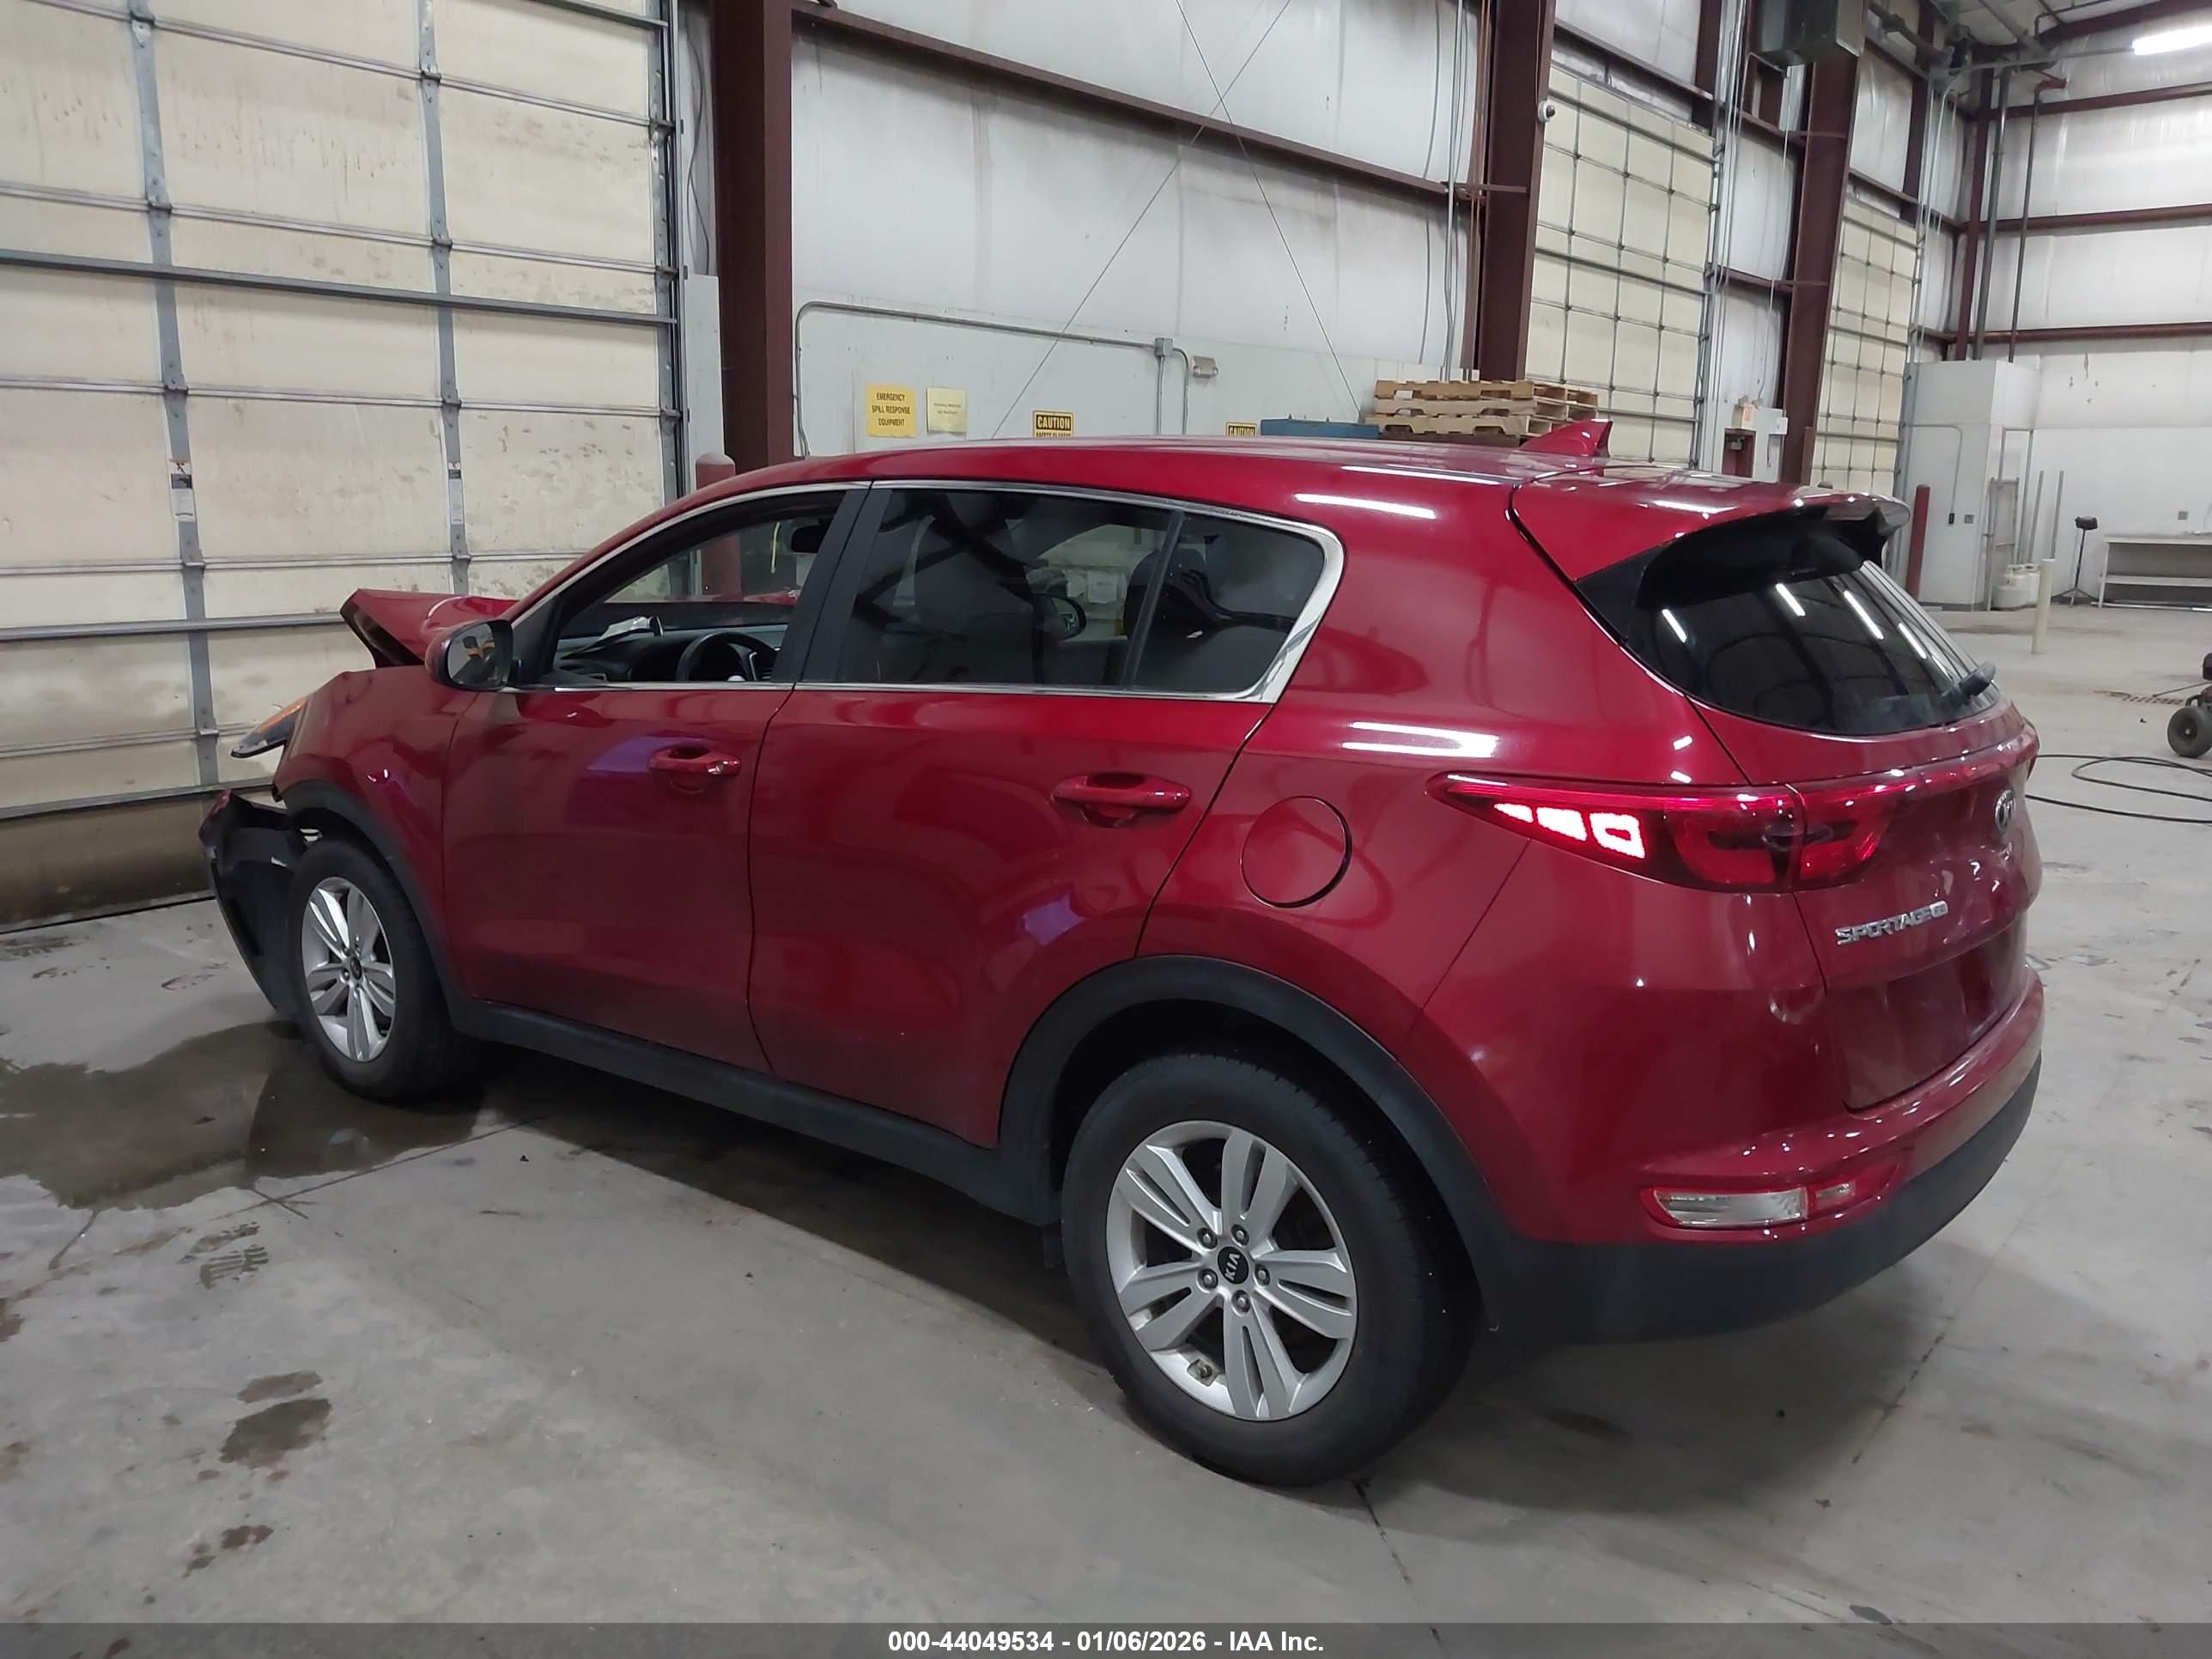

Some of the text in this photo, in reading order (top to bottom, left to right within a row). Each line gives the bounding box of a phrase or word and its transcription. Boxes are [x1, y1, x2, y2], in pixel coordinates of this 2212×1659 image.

[876, 392, 905, 401] EMERGENCY
[872, 404, 910, 414] SPILL RESPONSE
[1037, 416, 1070, 429] CAUTION
[1835, 906, 1932, 945] SPORTAGE
